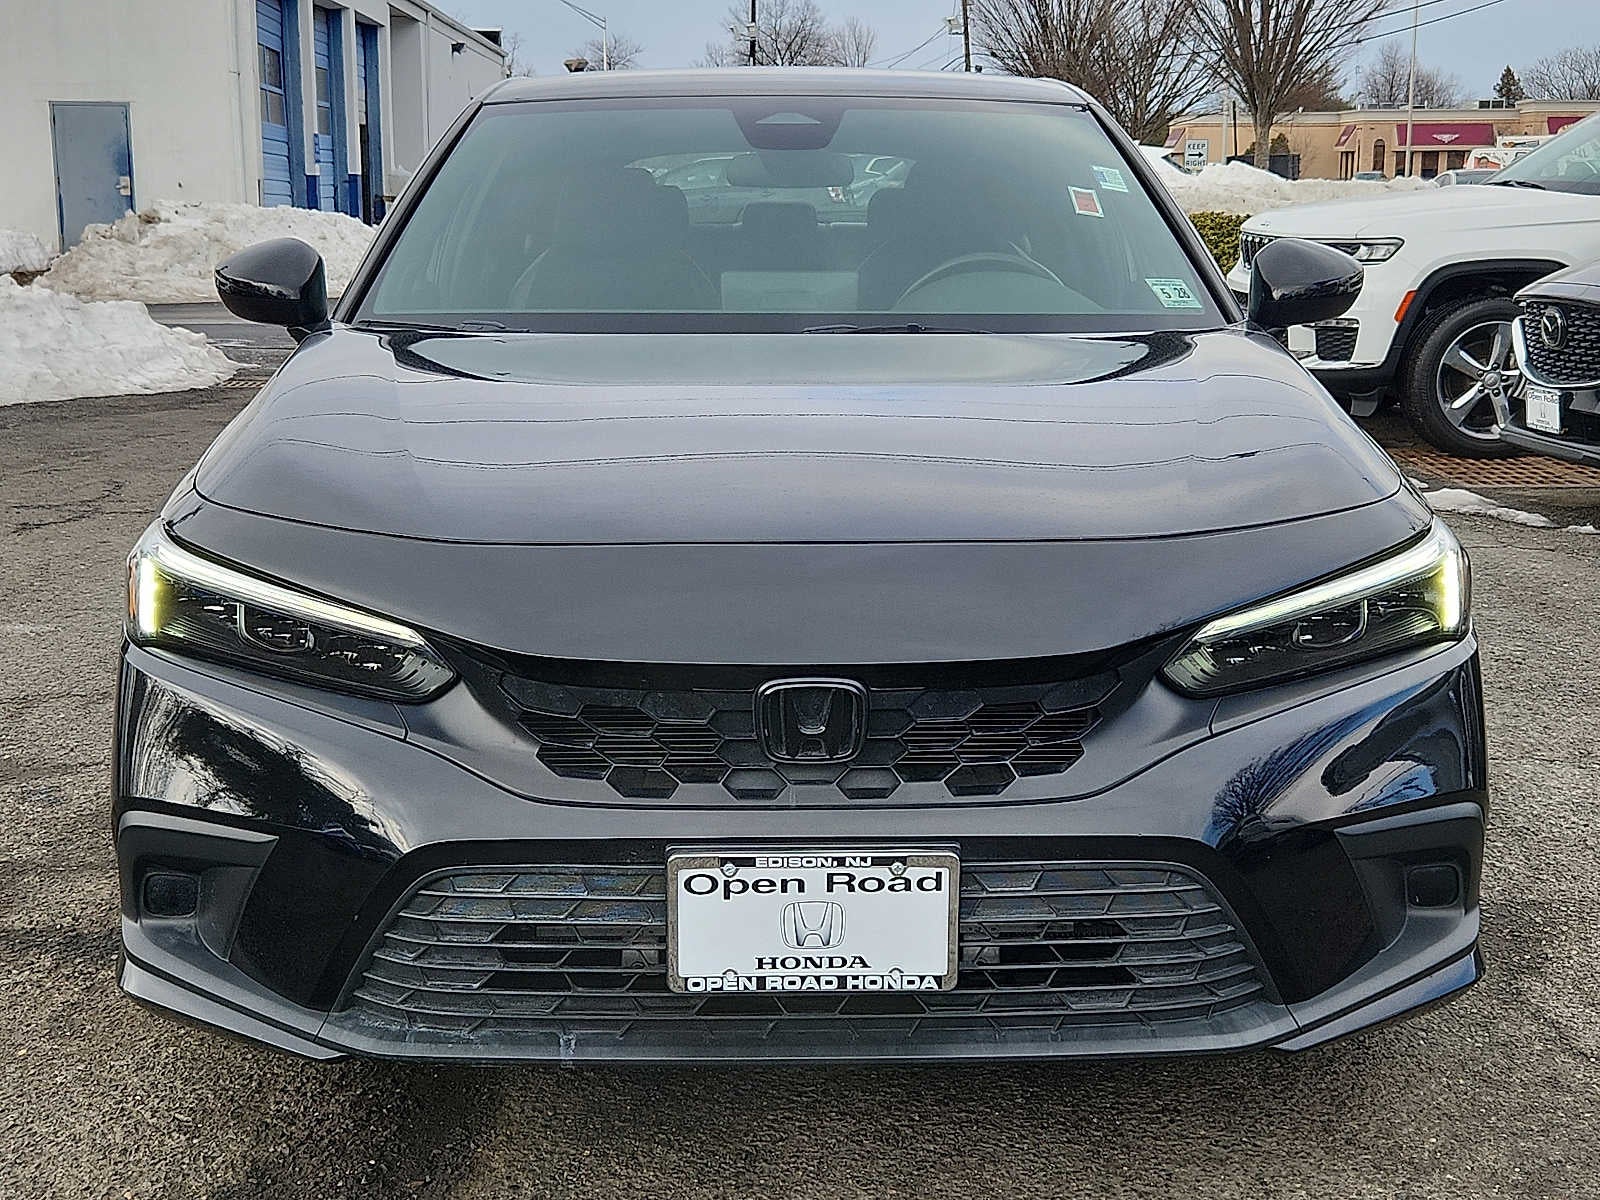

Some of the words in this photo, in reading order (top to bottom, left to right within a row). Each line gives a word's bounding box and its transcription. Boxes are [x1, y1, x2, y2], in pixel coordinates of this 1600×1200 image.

[1160, 288, 1172, 299] 5
[1173, 288, 1191, 299] 28
[1528, 391, 1542, 401] Open
[755, 857, 838, 868] EDISON,
[846, 857, 872, 867] NJ
[683, 873, 806, 900] Open
[826, 872, 943, 893] Road
[755, 956, 872, 970] HONDA
[687, 976, 757, 991] OPEN
[766, 976, 838, 991] ROAD
[846, 976, 939, 990] HONDA
